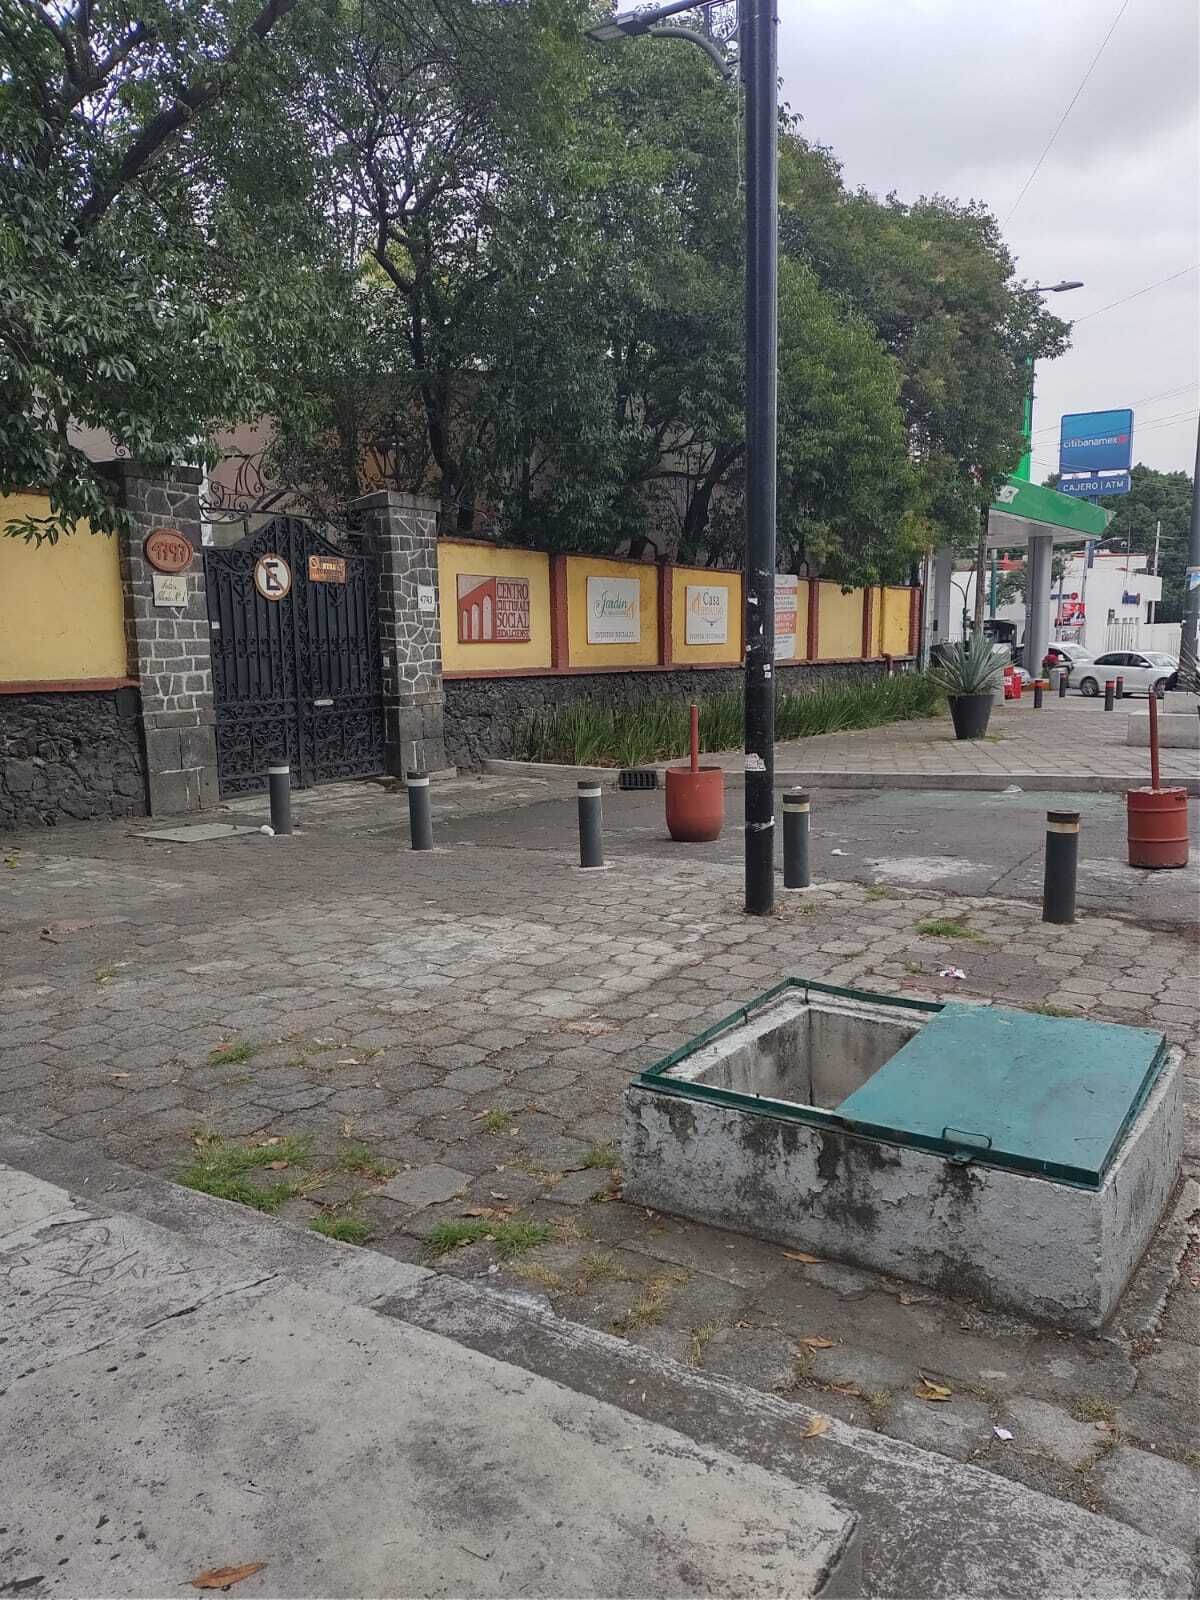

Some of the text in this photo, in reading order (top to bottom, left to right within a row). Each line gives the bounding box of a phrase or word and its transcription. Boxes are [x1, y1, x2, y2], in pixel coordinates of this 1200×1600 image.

[1063, 436, 1118, 448] citibanamex
[1063, 480, 1124, 492] CAJERO ATM
[265, 562, 281, 591] E
[497, 583, 529, 600] CENTRO
[703, 591, 720, 606] Casa
[497, 611, 530, 629] SOCIAL
